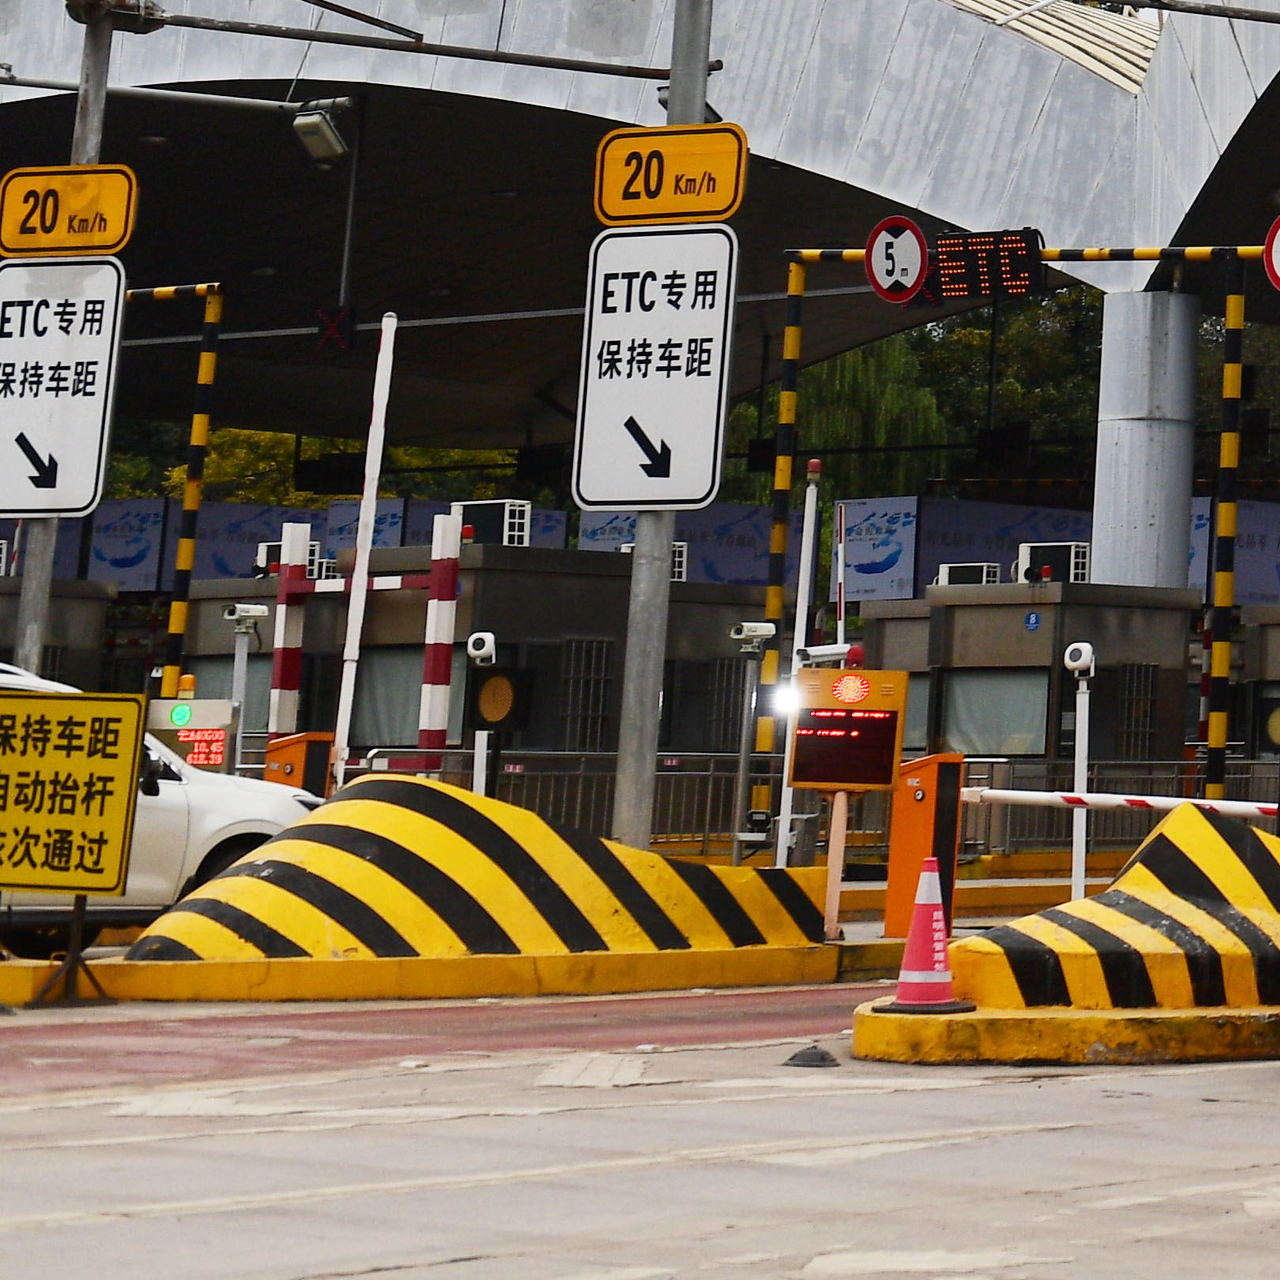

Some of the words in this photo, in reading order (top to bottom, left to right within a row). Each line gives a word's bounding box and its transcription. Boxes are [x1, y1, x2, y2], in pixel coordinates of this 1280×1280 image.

[622, 150, 664, 200] 20
[673, 171, 717, 196] Km/h
[19, 189, 59, 234] 20
[67, 212, 107, 234] Km/h
[885, 242, 895, 277] 5
[937, 236, 1030, 296] ETC
[601, 270, 717, 314] ETC专用
[0, 299, 105, 338] ETC专用
[597, 337, 713, 380] 保持车距
[0, 826, 108, 874] 次通过
